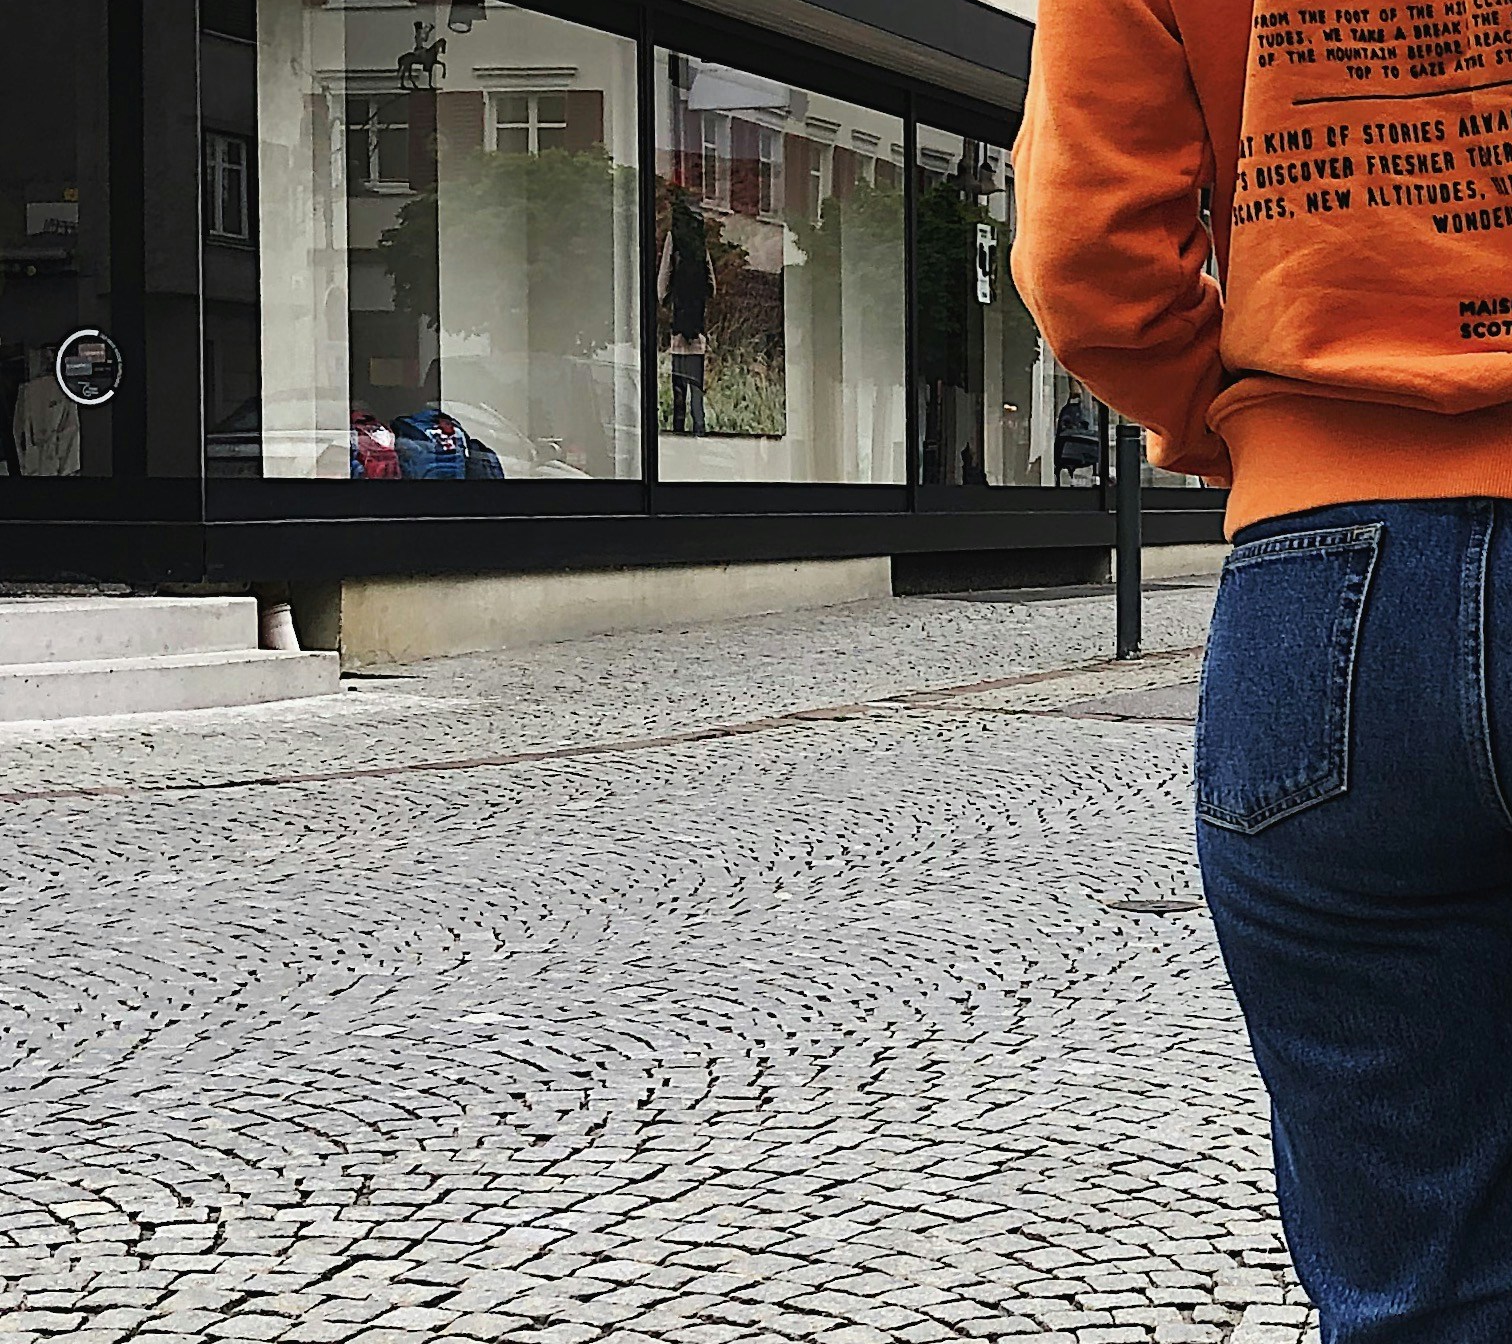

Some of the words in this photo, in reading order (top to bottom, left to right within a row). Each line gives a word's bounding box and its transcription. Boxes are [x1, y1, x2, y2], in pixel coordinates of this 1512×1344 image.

[1254, 11, 1290, 28] FROM
[1297, 9, 1326, 25] THE
[1335, 9, 1370, 25] FOOT
[1379, 7, 1398, 23] OF
[1405, 3, 1434, 21] THE
[1322, 27, 1343, 43] WE
[1350, 27, 1385, 44] TAKE
[1393, 26, 1407, 41] A
[1412, 20, 1462, 40] BREAK
[1471, 10, 1500, 27] THE
[1258, 52, 1275, 68] OF
[1285, 48, 1316, 64] THE
[1325, 46, 1397, 63] MOUNTAIN
[1407, 39, 1464, 61] BEFORE
[1345, 65, 1372, 80] TOP
[1381, 65, 1400, 80] TO
[1409, 60, 1446, 79] GAZE
[1264, 128, 1313, 155] KIND
[1326, 124, 1350, 148] OF
[1362, 119, 1445, 145] STORIES
[1256, 156, 1354, 189] DISCOVER
[1366, 151, 1455, 176] FRESHER
[1306, 189, 1351, 214] NEW
[1367, 179, 1486, 207] ALTITUDES,
